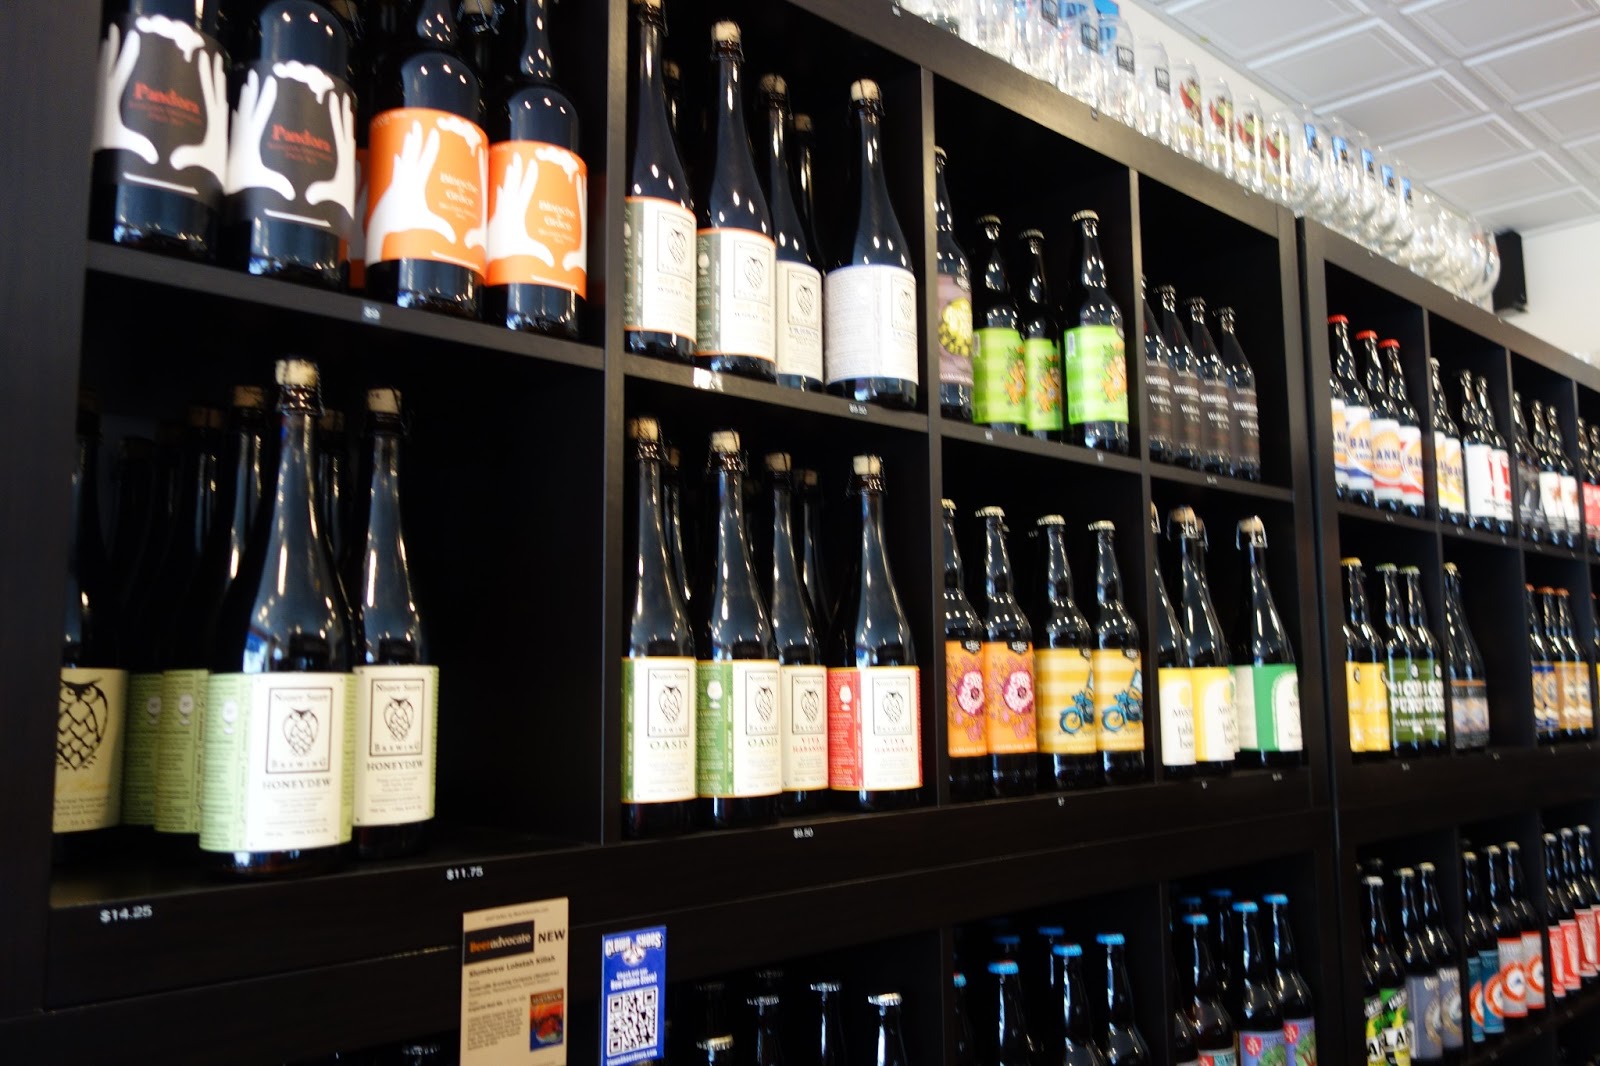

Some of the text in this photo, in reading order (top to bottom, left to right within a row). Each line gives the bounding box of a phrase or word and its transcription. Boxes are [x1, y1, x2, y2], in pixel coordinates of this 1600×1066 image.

[262, 778, 332, 790] HONEYDEW
[446, 865, 484, 881] $11.75
[100, 904, 153, 923] $14.25
[538, 928, 566, 943] NEW
